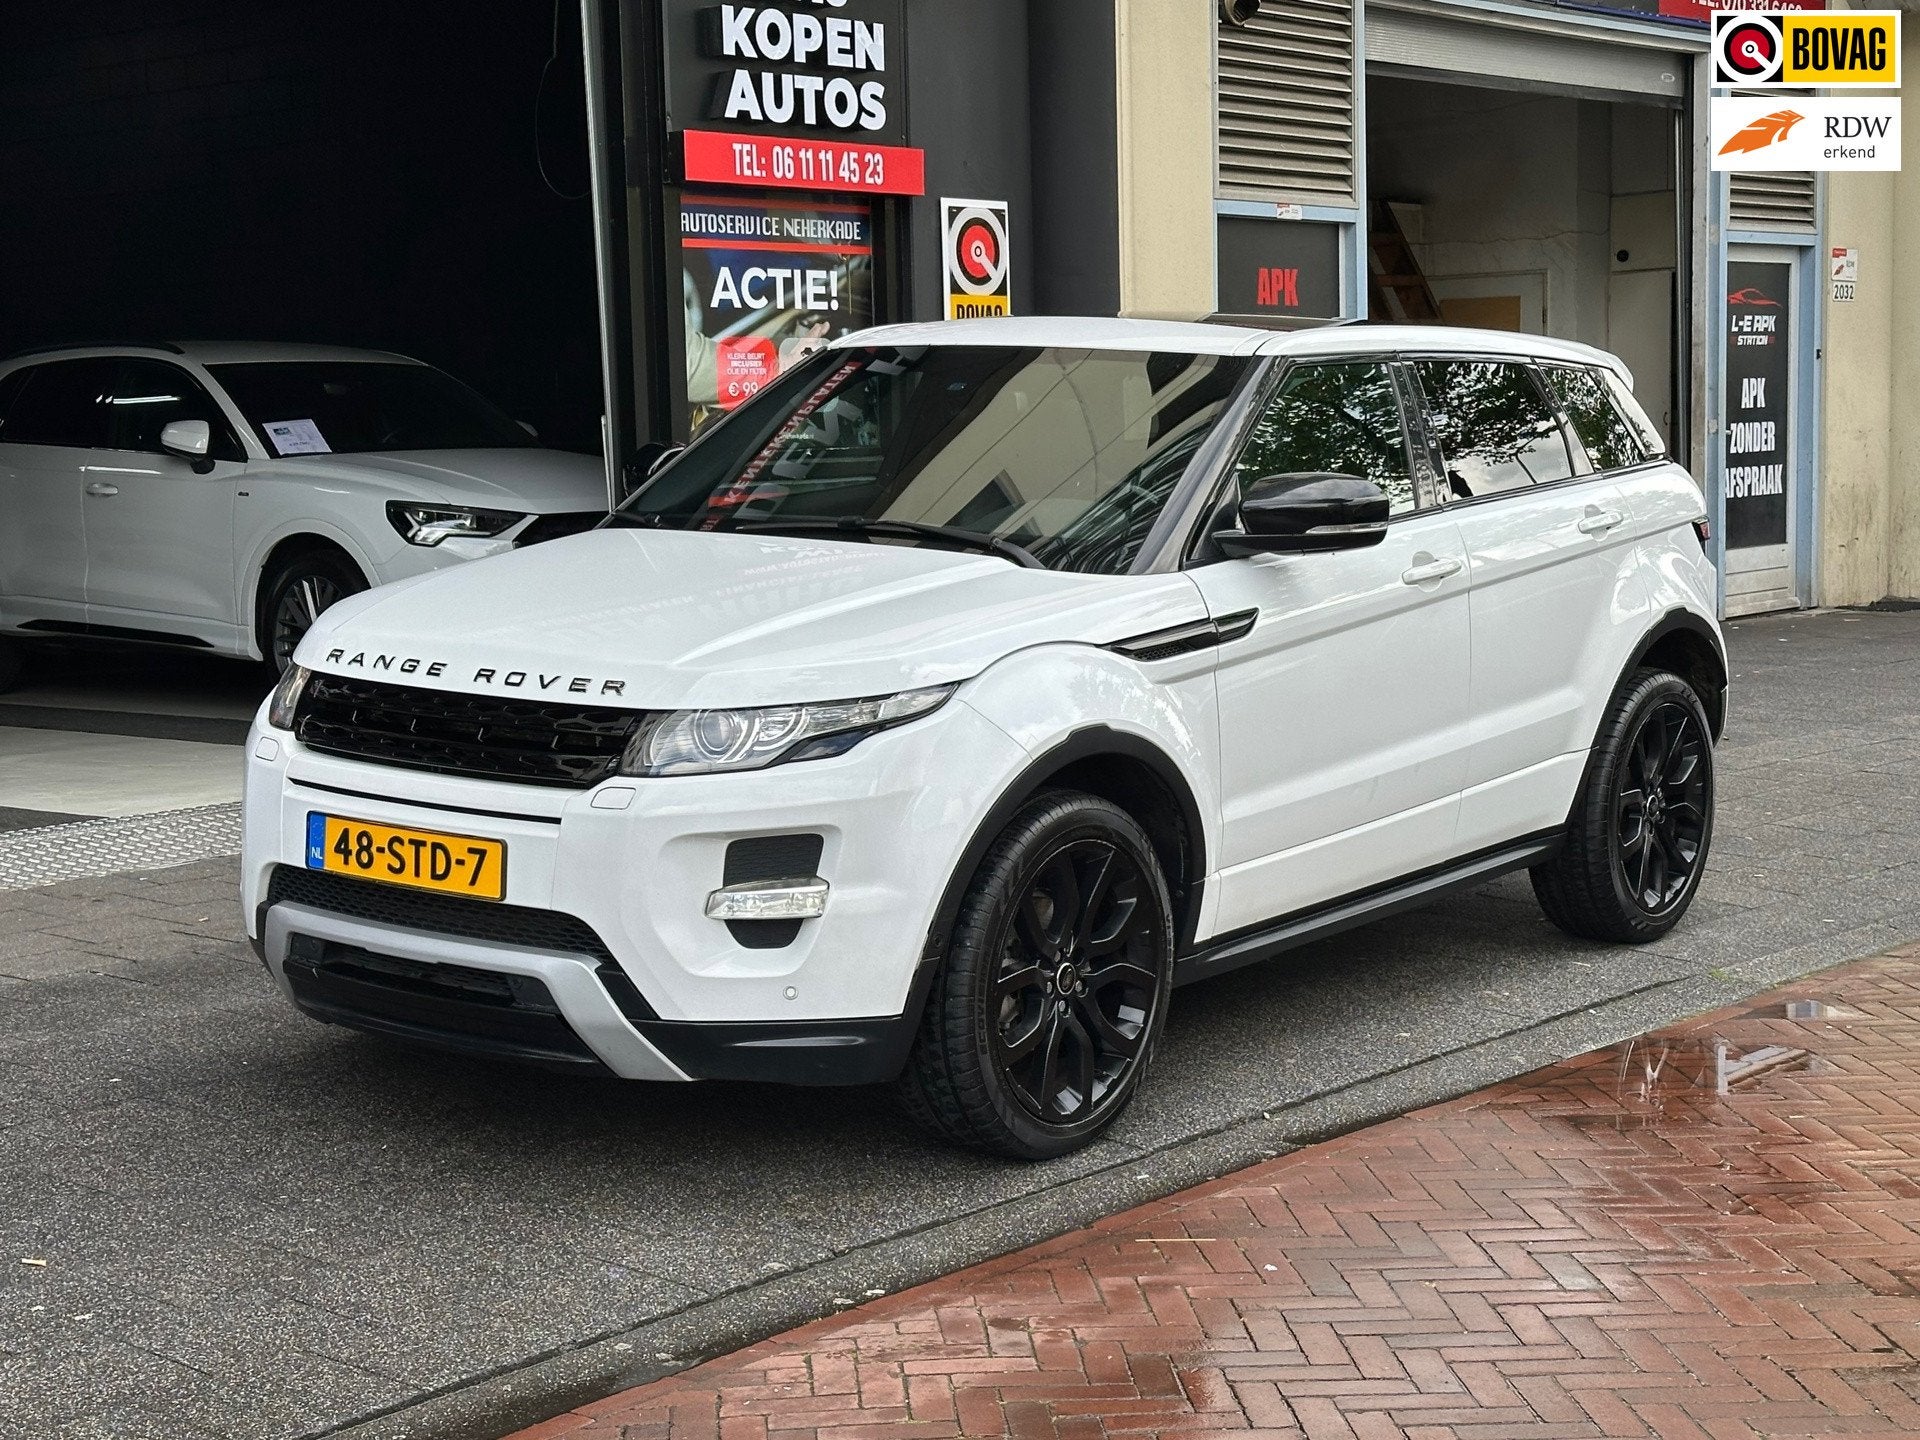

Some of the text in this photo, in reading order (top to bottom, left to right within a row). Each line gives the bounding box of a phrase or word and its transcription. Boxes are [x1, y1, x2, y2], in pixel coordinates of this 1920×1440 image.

[721, 4, 885, 71] KOPEN
[724, 69, 887, 130] AUTOS
[732, 143, 885, 186] TEL: 06 11 11 45 23
[681, 212, 862, 240] AUTOSERVICE NEHERKADE
[710, 266, 839, 311] ACTIE!
[1256, 267, 1299, 307] APK
[1834, 284, 1854, 299] 2032
[1731, 315, 1776, 332] L-E APK
[728, 381, 759, 397] € 99
[1741, 378, 1766, 409] APK
[1730, 421, 1776, 454] ZONDER
[326, 648, 627, 697] RANGE ROVER
[311, 846, 324, 860] NL
[333, 827, 488, 887] 48-STD-7
